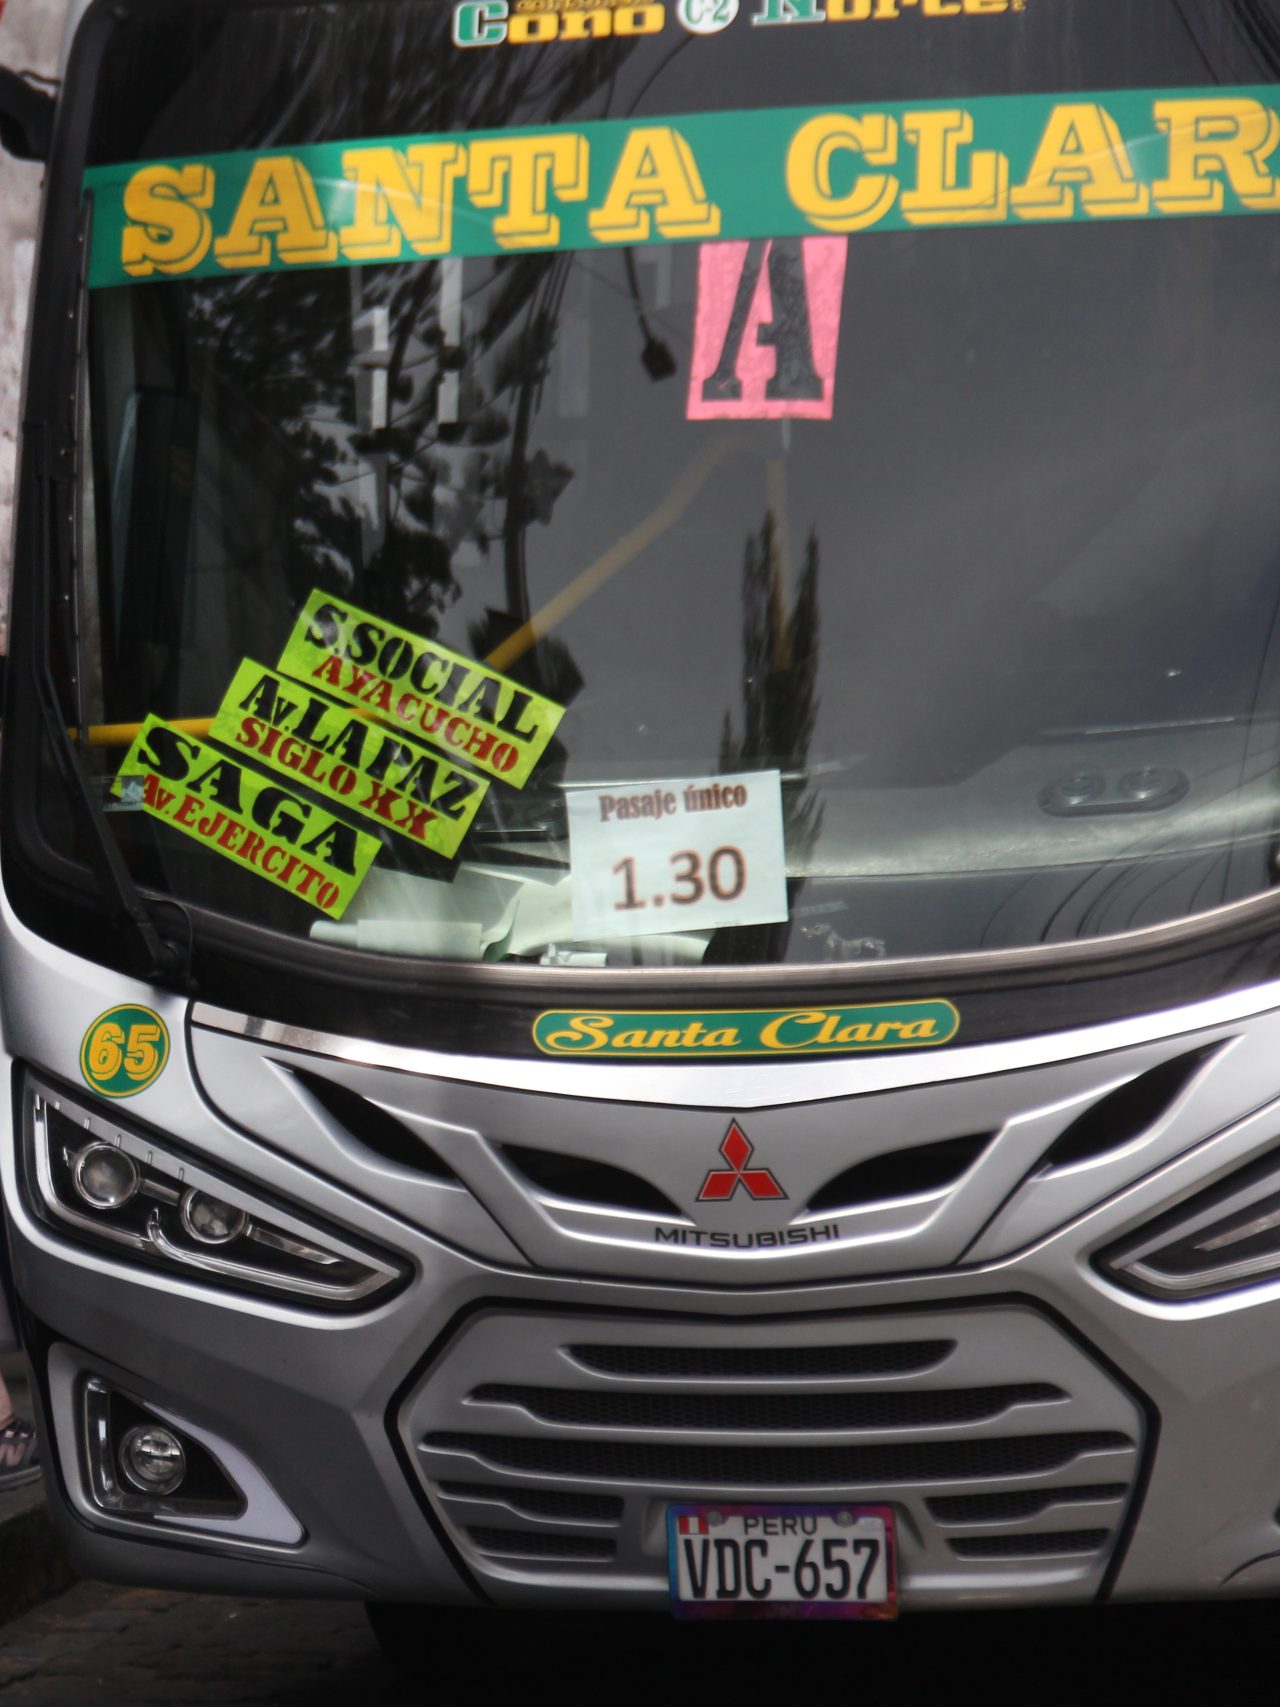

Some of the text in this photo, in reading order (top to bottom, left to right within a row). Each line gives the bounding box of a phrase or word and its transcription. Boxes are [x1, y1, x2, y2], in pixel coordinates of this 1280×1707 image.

[455, 0, 665, 47] Cono
[122, 98, 1280, 277] SANTA CLAR
[700, 238, 825, 402] A
[312, 655, 519, 773] AYACUCHO
[138, 726, 359, 877] SAGA
[236, 717, 439, 841] SIGLO XX
[598, 783, 748, 822] Pasaje único
[612, 845, 748, 911] 1.30
[89, 1022, 161, 1081] 65
[545, 1010, 939, 1051] Santa Clara
[655, 1224, 839, 1248] MITSUBISHI
[743, 1516, 818, 1536] PERU
[683, 1538, 880, 1600] VDC-657
